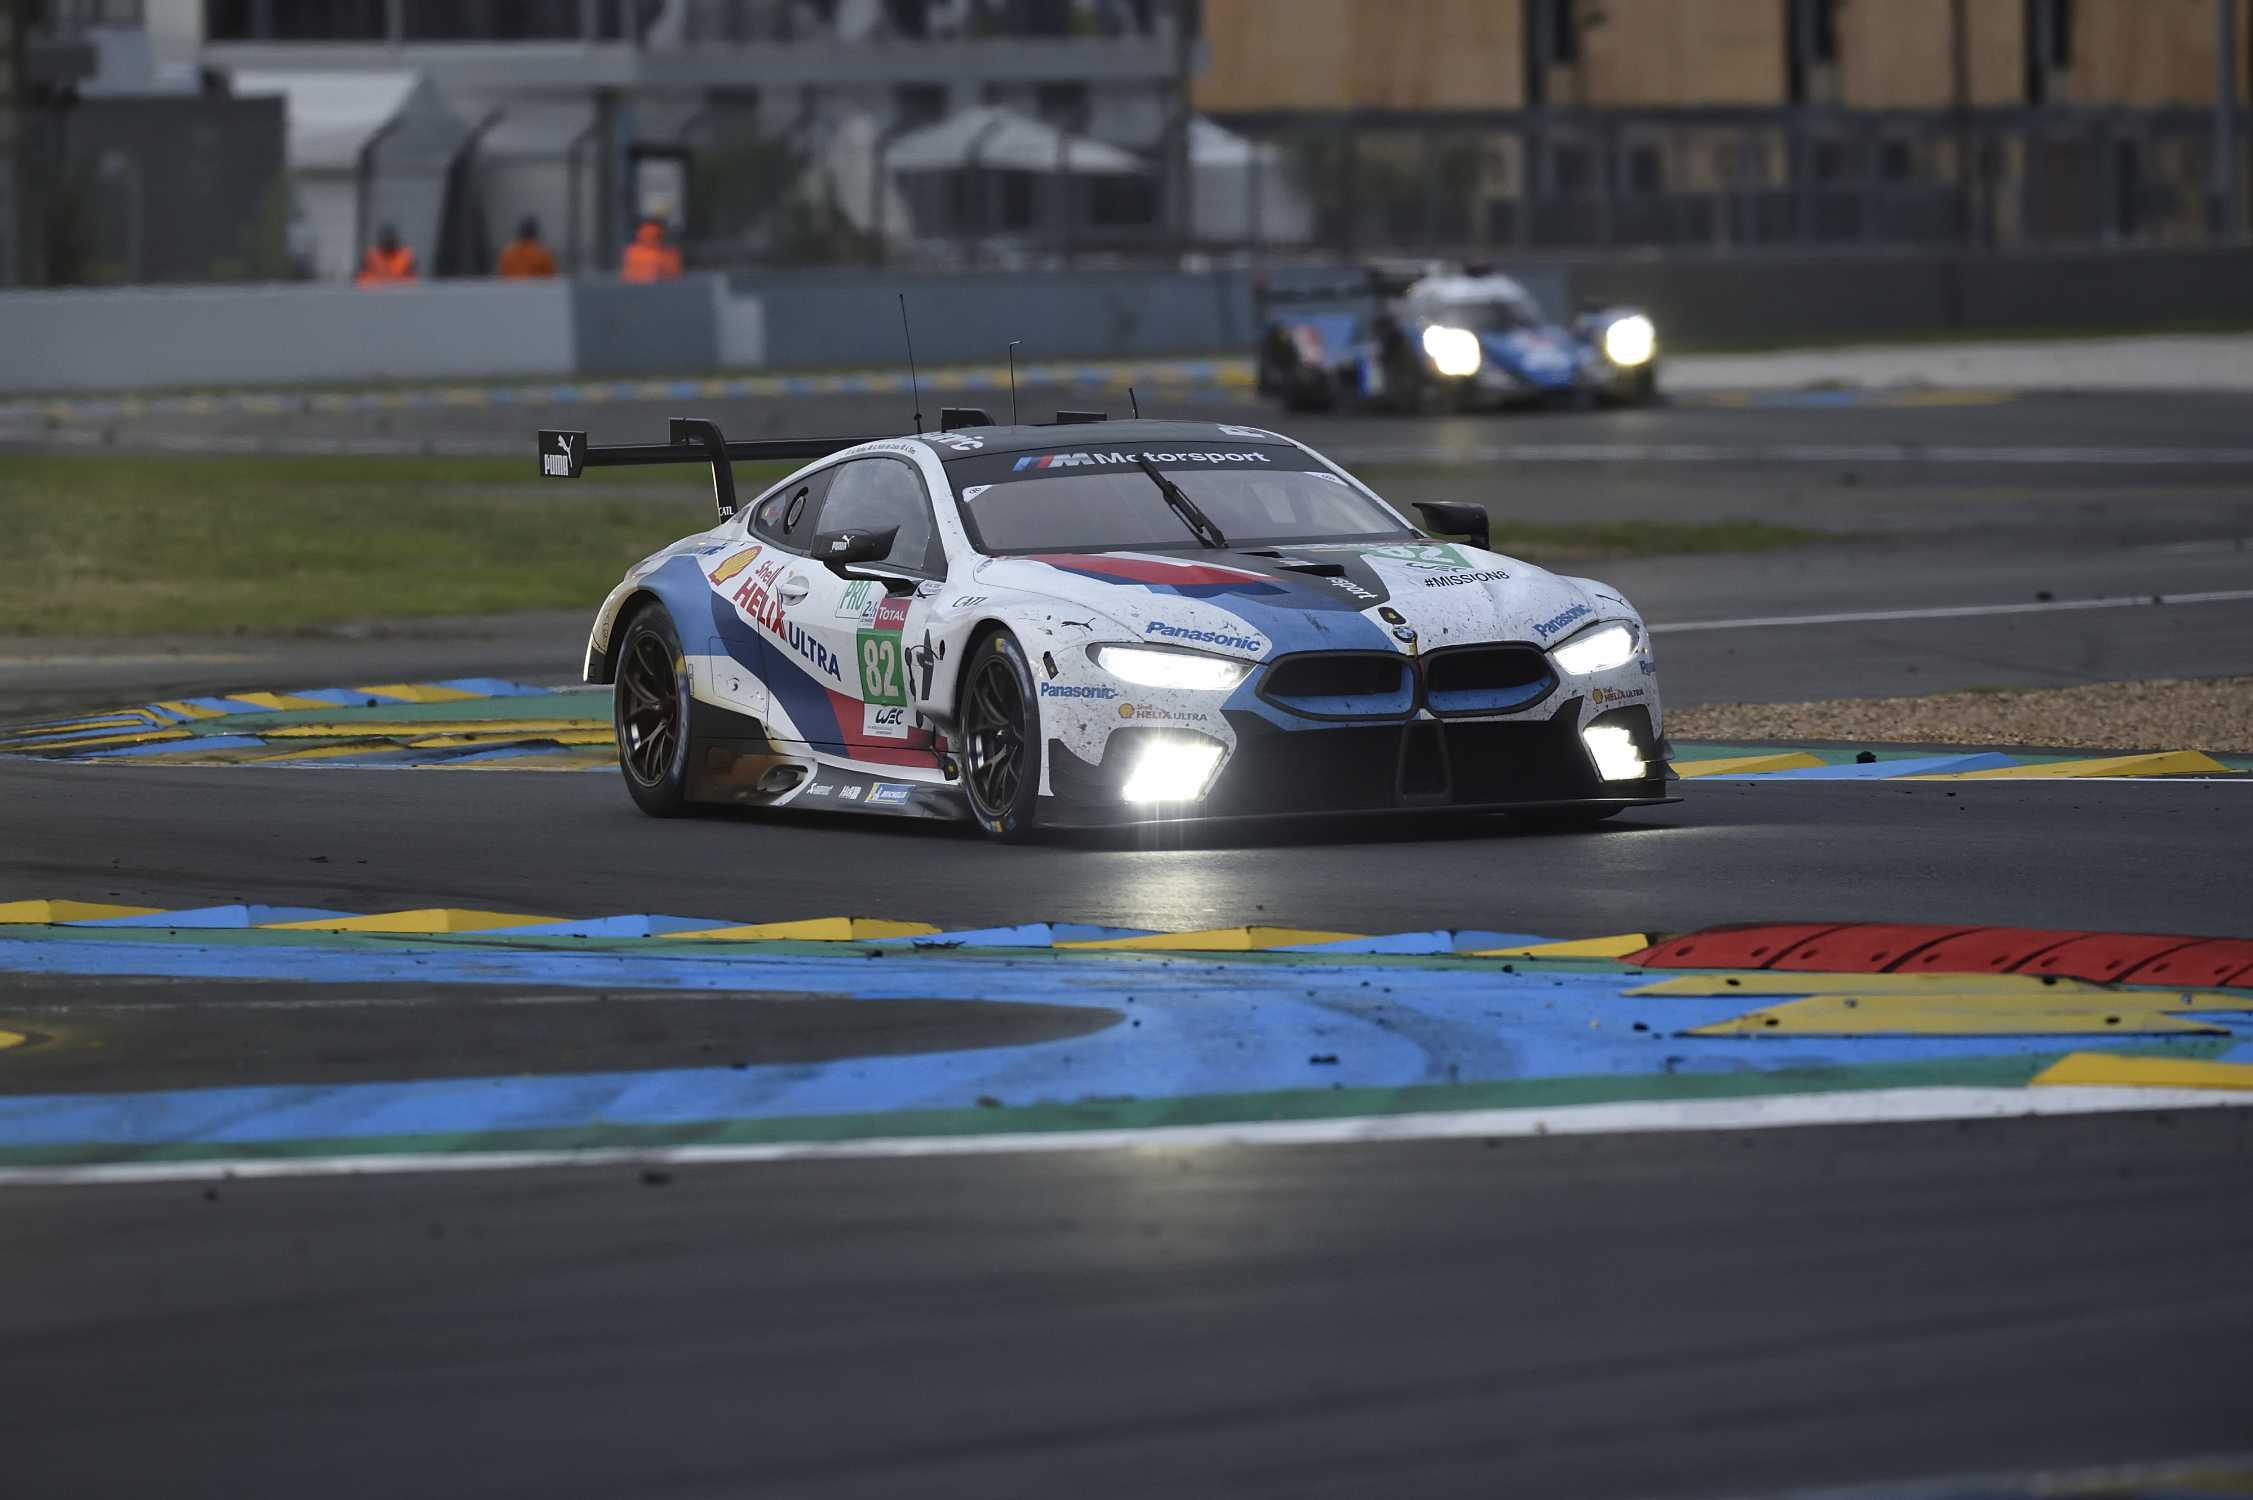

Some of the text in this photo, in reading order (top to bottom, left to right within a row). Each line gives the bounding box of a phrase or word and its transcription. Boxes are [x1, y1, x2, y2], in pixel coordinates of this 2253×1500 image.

[544, 454, 569, 476] PUMA
[1093, 451, 1273, 464] Motorsport
[755, 560, 785, 587] Shell
[1424, 570, 1511, 588] #MISSION8
[840, 581, 873, 611] PRO
[732, 576, 842, 682] HELIX ULTRA
[1145, 621, 1261, 652] Panasonic
[863, 639, 899, 697] 82
[1040, 682, 1116, 699] Panasonic
[875, 707, 904, 725] WEC
[1173, 712, 1208, 721] ULTRA
